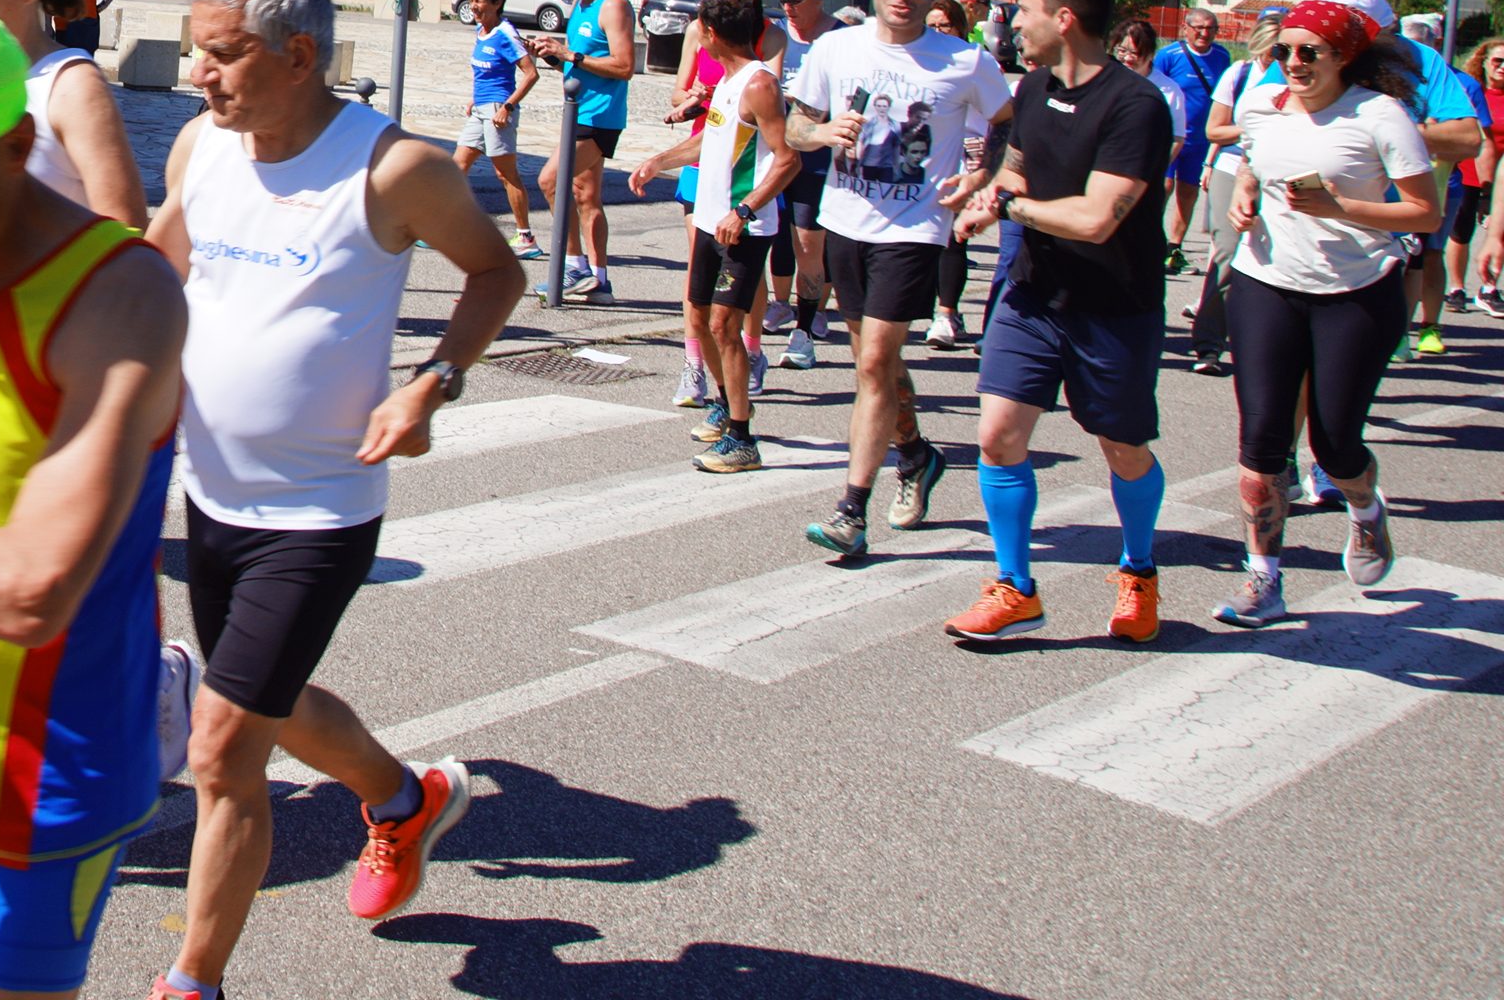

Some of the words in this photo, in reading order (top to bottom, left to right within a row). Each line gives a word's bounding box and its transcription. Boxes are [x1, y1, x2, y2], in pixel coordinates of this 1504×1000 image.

[839, 76, 939, 107] EDWARD
[872, 69, 905, 83] TEAM
[837, 172, 921, 203] FOREVER
